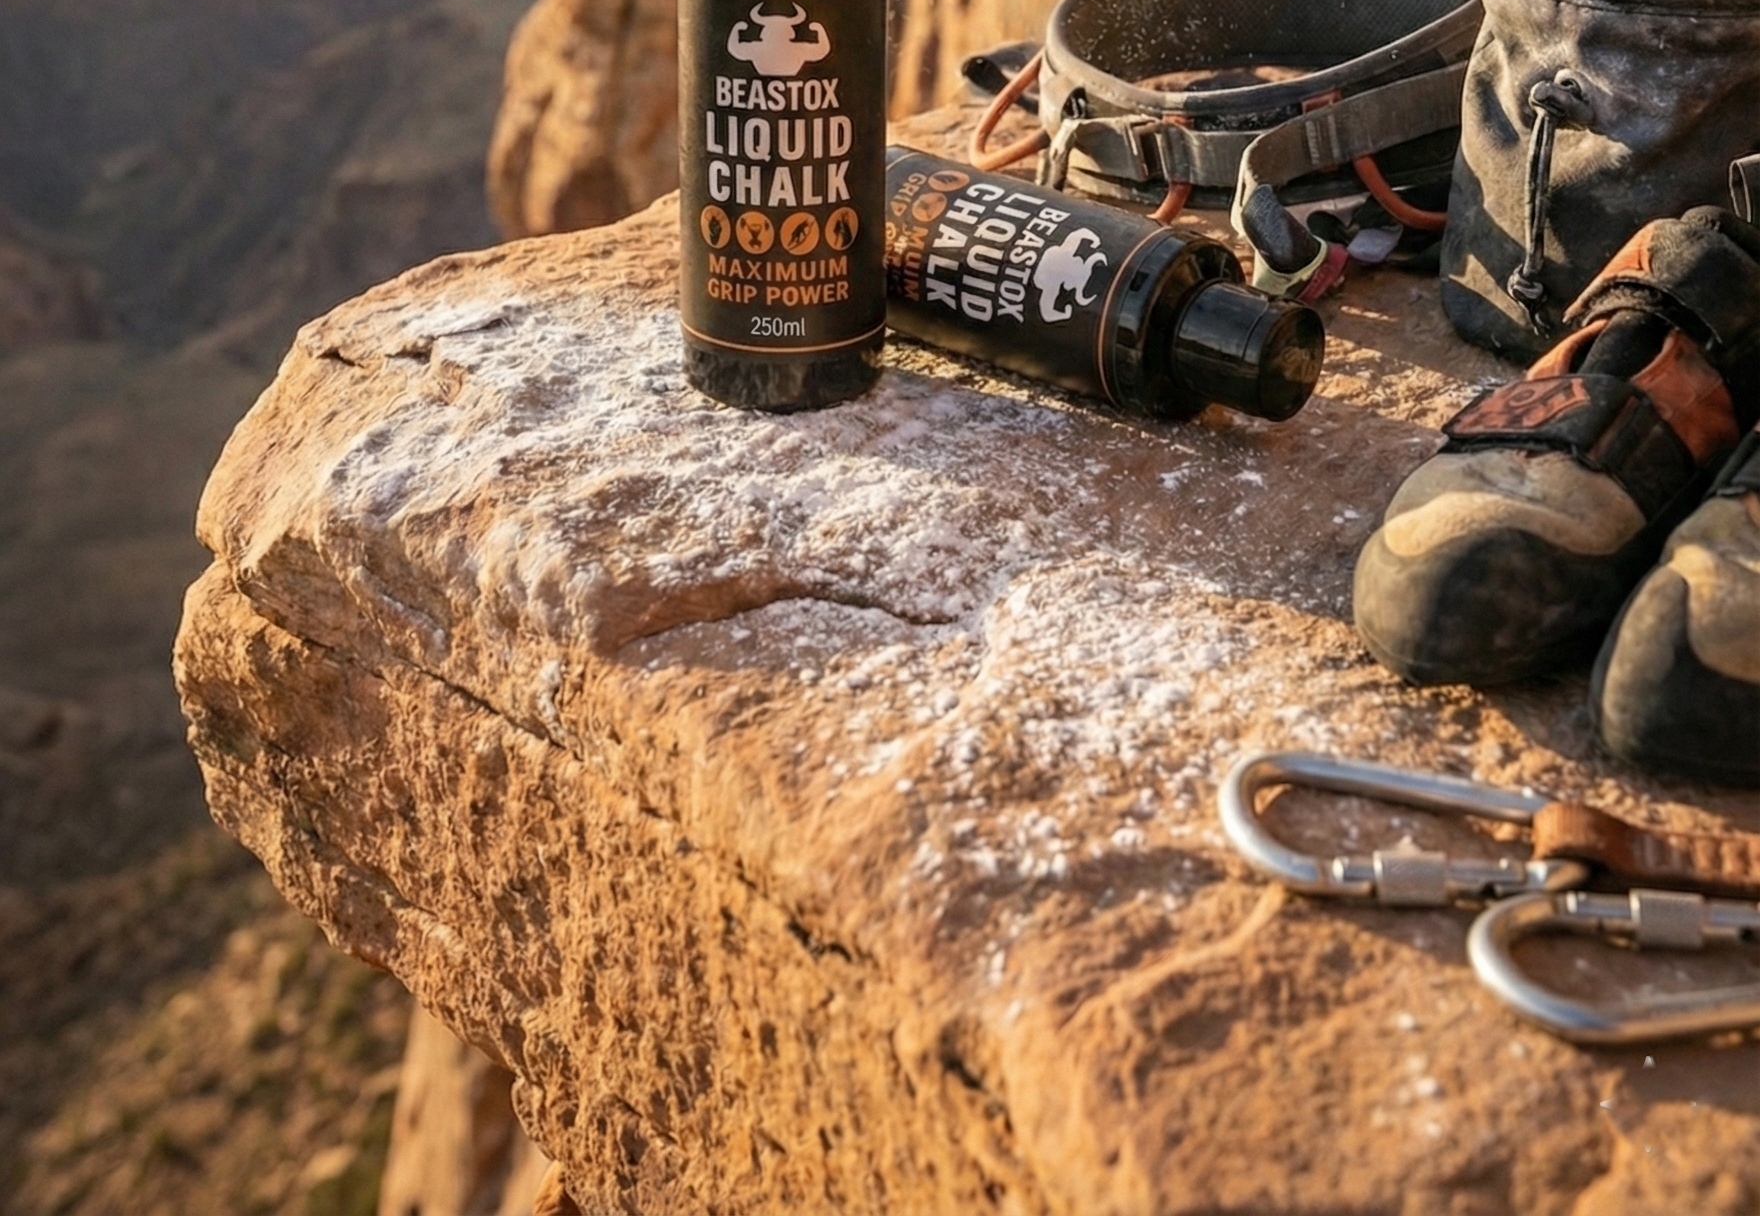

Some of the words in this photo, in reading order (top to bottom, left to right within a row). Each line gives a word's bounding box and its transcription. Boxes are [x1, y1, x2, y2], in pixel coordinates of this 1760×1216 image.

[715, 75, 839, 112] BEASTOX
[706, 110, 852, 162] LIQUID
[708, 159, 850, 207] CHALK
[925, 183, 1006, 311] CHALK
[960, 192, 1047, 322] LIQUID
[997, 206, 1071, 324] BEASTOX
[707, 278, 758, 304] GRIP
[766, 280, 849, 307] POWER
[750, 316, 806, 337] 250ml
